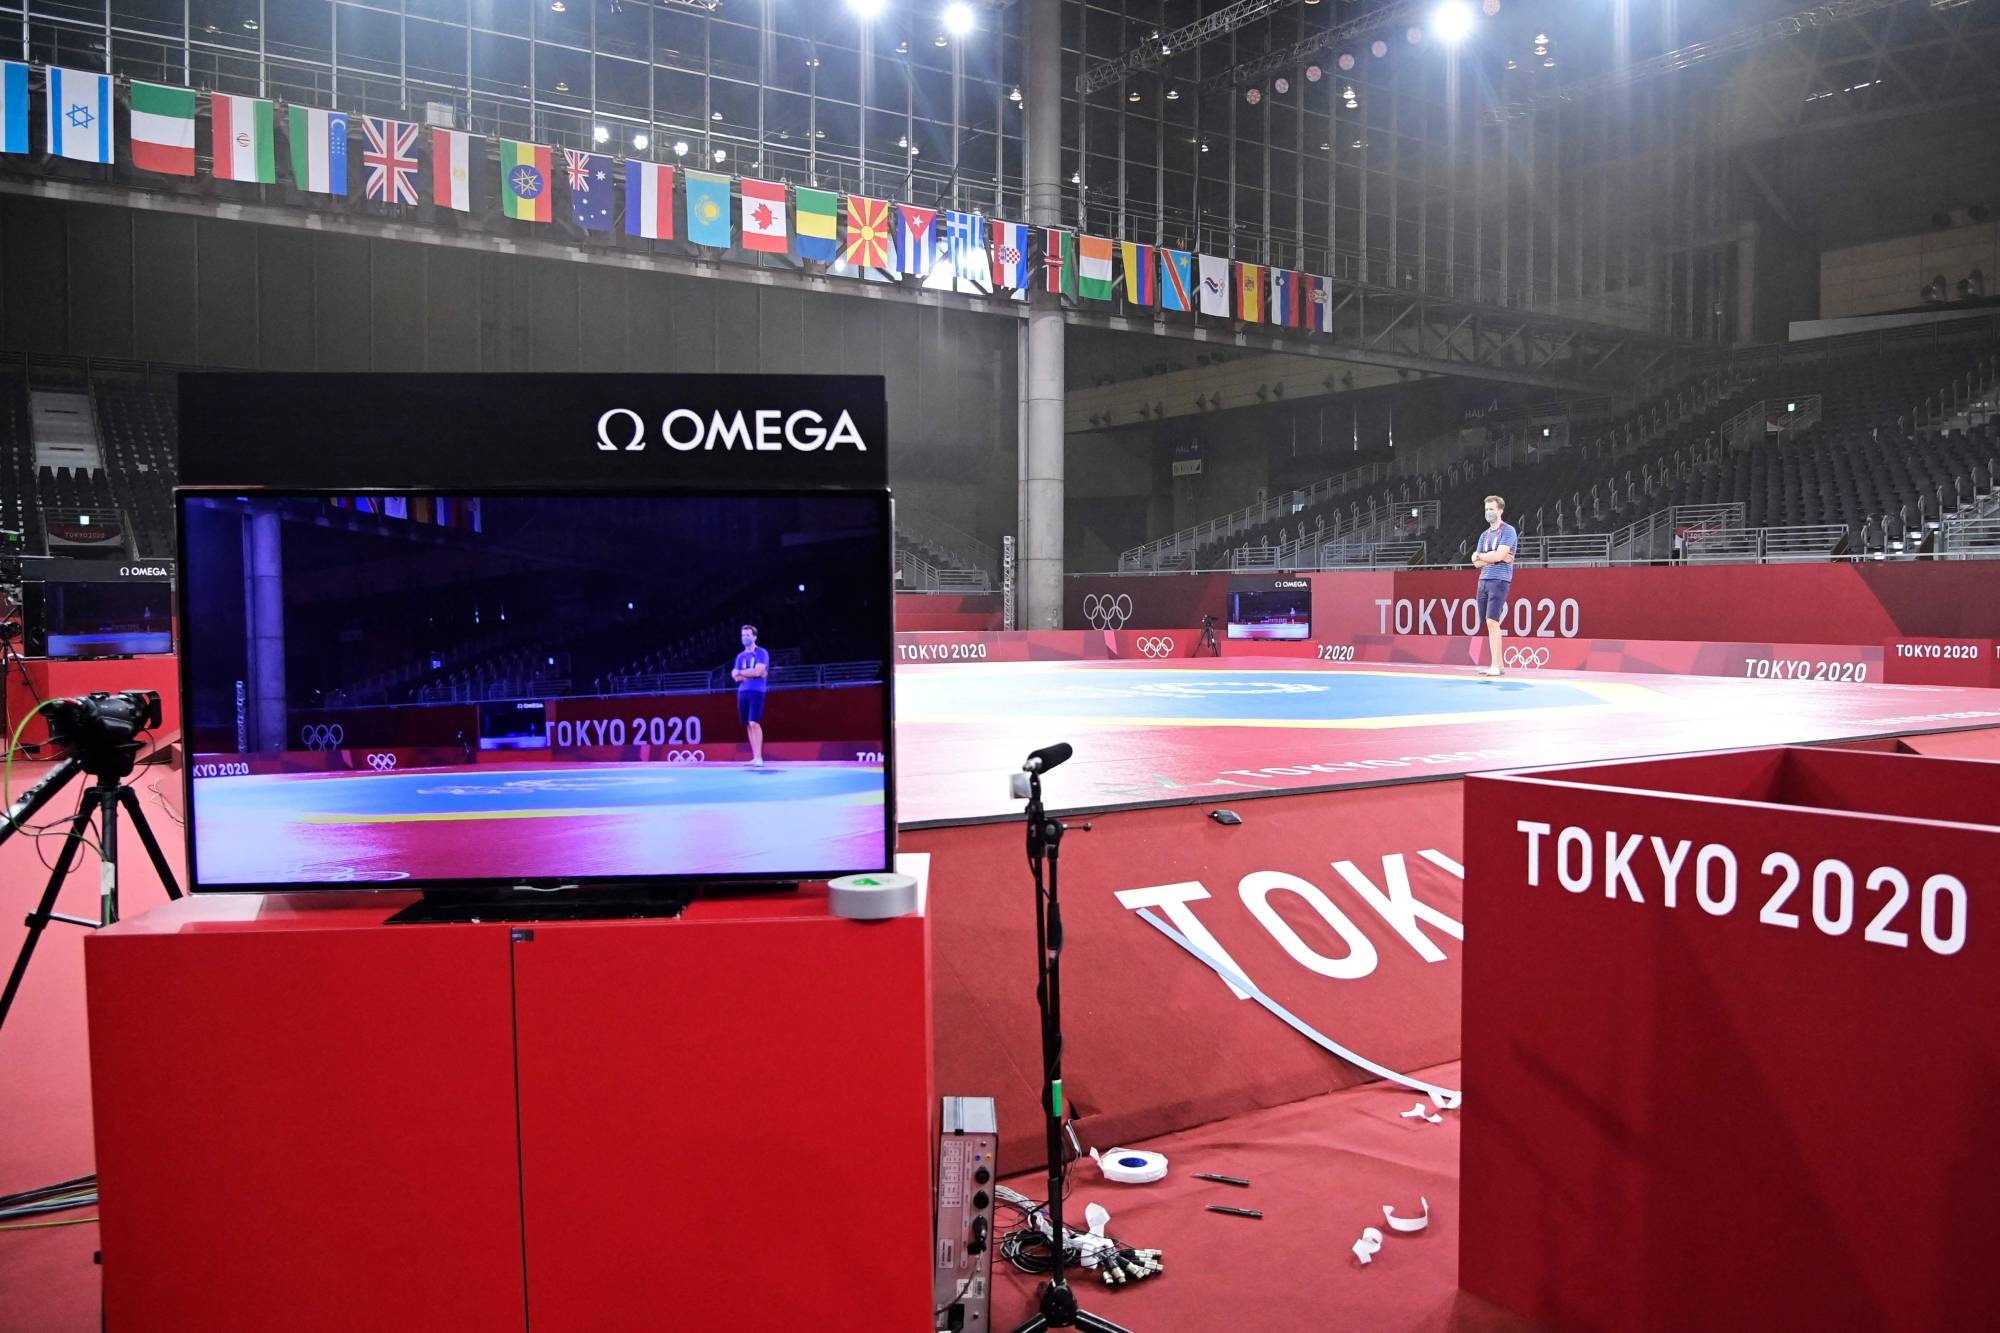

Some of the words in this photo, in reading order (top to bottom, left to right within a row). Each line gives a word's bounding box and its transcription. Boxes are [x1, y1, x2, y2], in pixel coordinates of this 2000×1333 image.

[661, 408, 868, 451] OMEGA
[131, 567, 167, 576] OMEGA
[1375, 598, 1481, 636] TOKYO
[898, 644, 948, 660] TOKYO
[952, 643, 987, 659] 2020
[1324, 645, 1355, 661] 2020
[1896, 644, 1941, 658] TOKYO
[1943, 645, 1978, 659] 2020
[1745, 658, 1811, 680] TOKYO
[1813, 661, 1867, 683] 2020
[545, 718, 626, 747] TOKYO
[632, 715, 702, 746] 2020
[193, 764, 218, 777] KYO
[219, 762, 249, 776] 2020
[1517, 820, 1738, 917] TOKYO
[1759, 851, 1968, 956] 2020
[1113, 848, 1464, 1001] TOK
